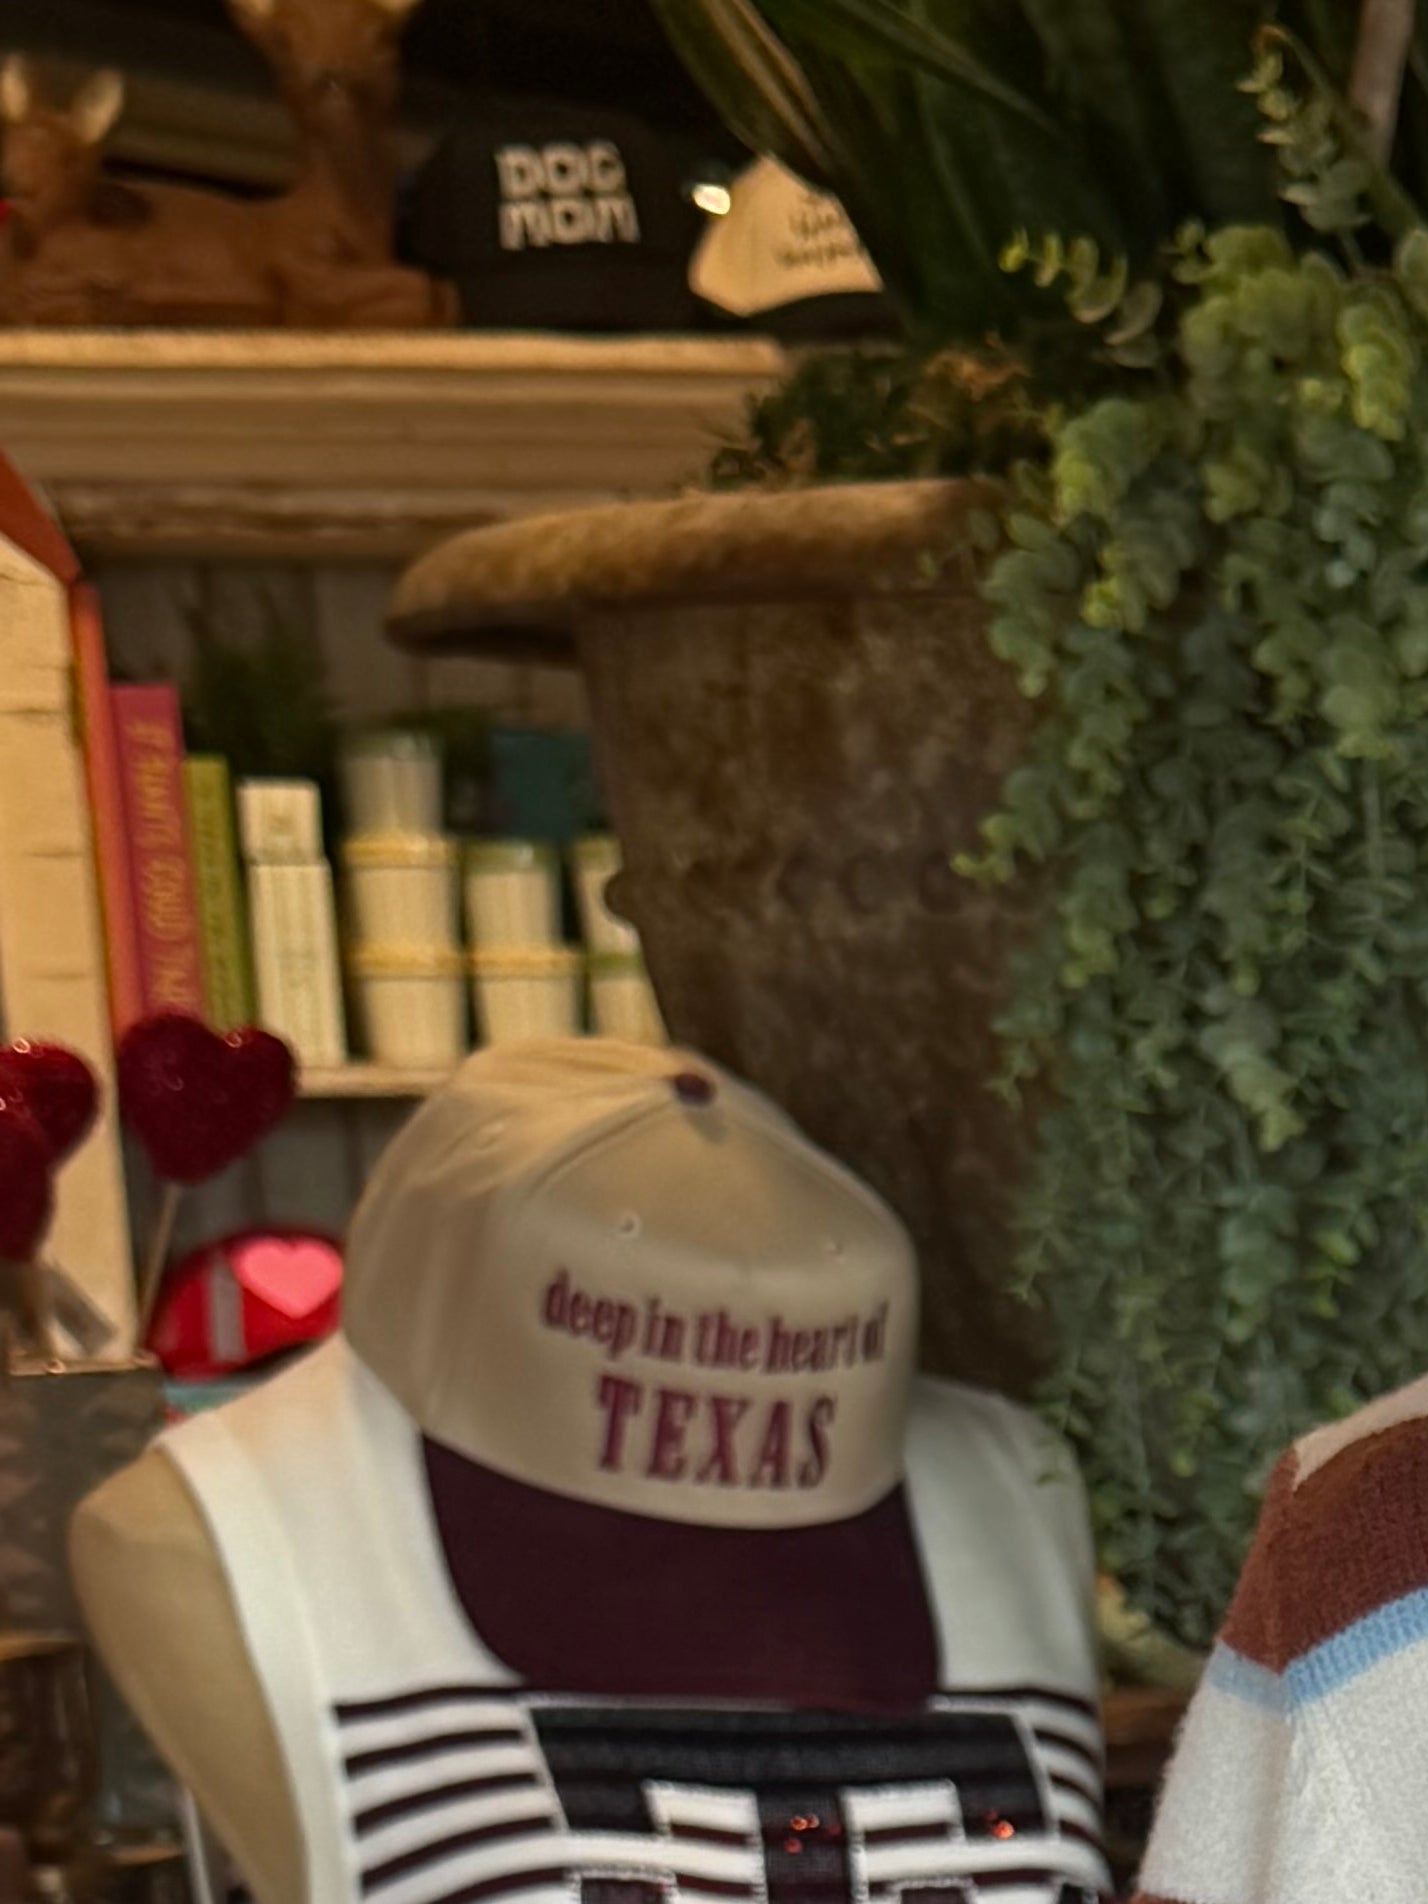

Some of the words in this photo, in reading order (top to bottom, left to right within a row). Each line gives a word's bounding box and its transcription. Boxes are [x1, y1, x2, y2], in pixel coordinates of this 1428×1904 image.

[494, 142, 626, 199] DOG
[500, 198, 640, 249] MOM
[541, 1267, 639, 1360] deep
[643, 1296, 686, 1365] in
[694, 1304, 761, 1371] the
[761, 1313, 861, 1374] heart
[594, 1373, 837, 1490] TEXAS
